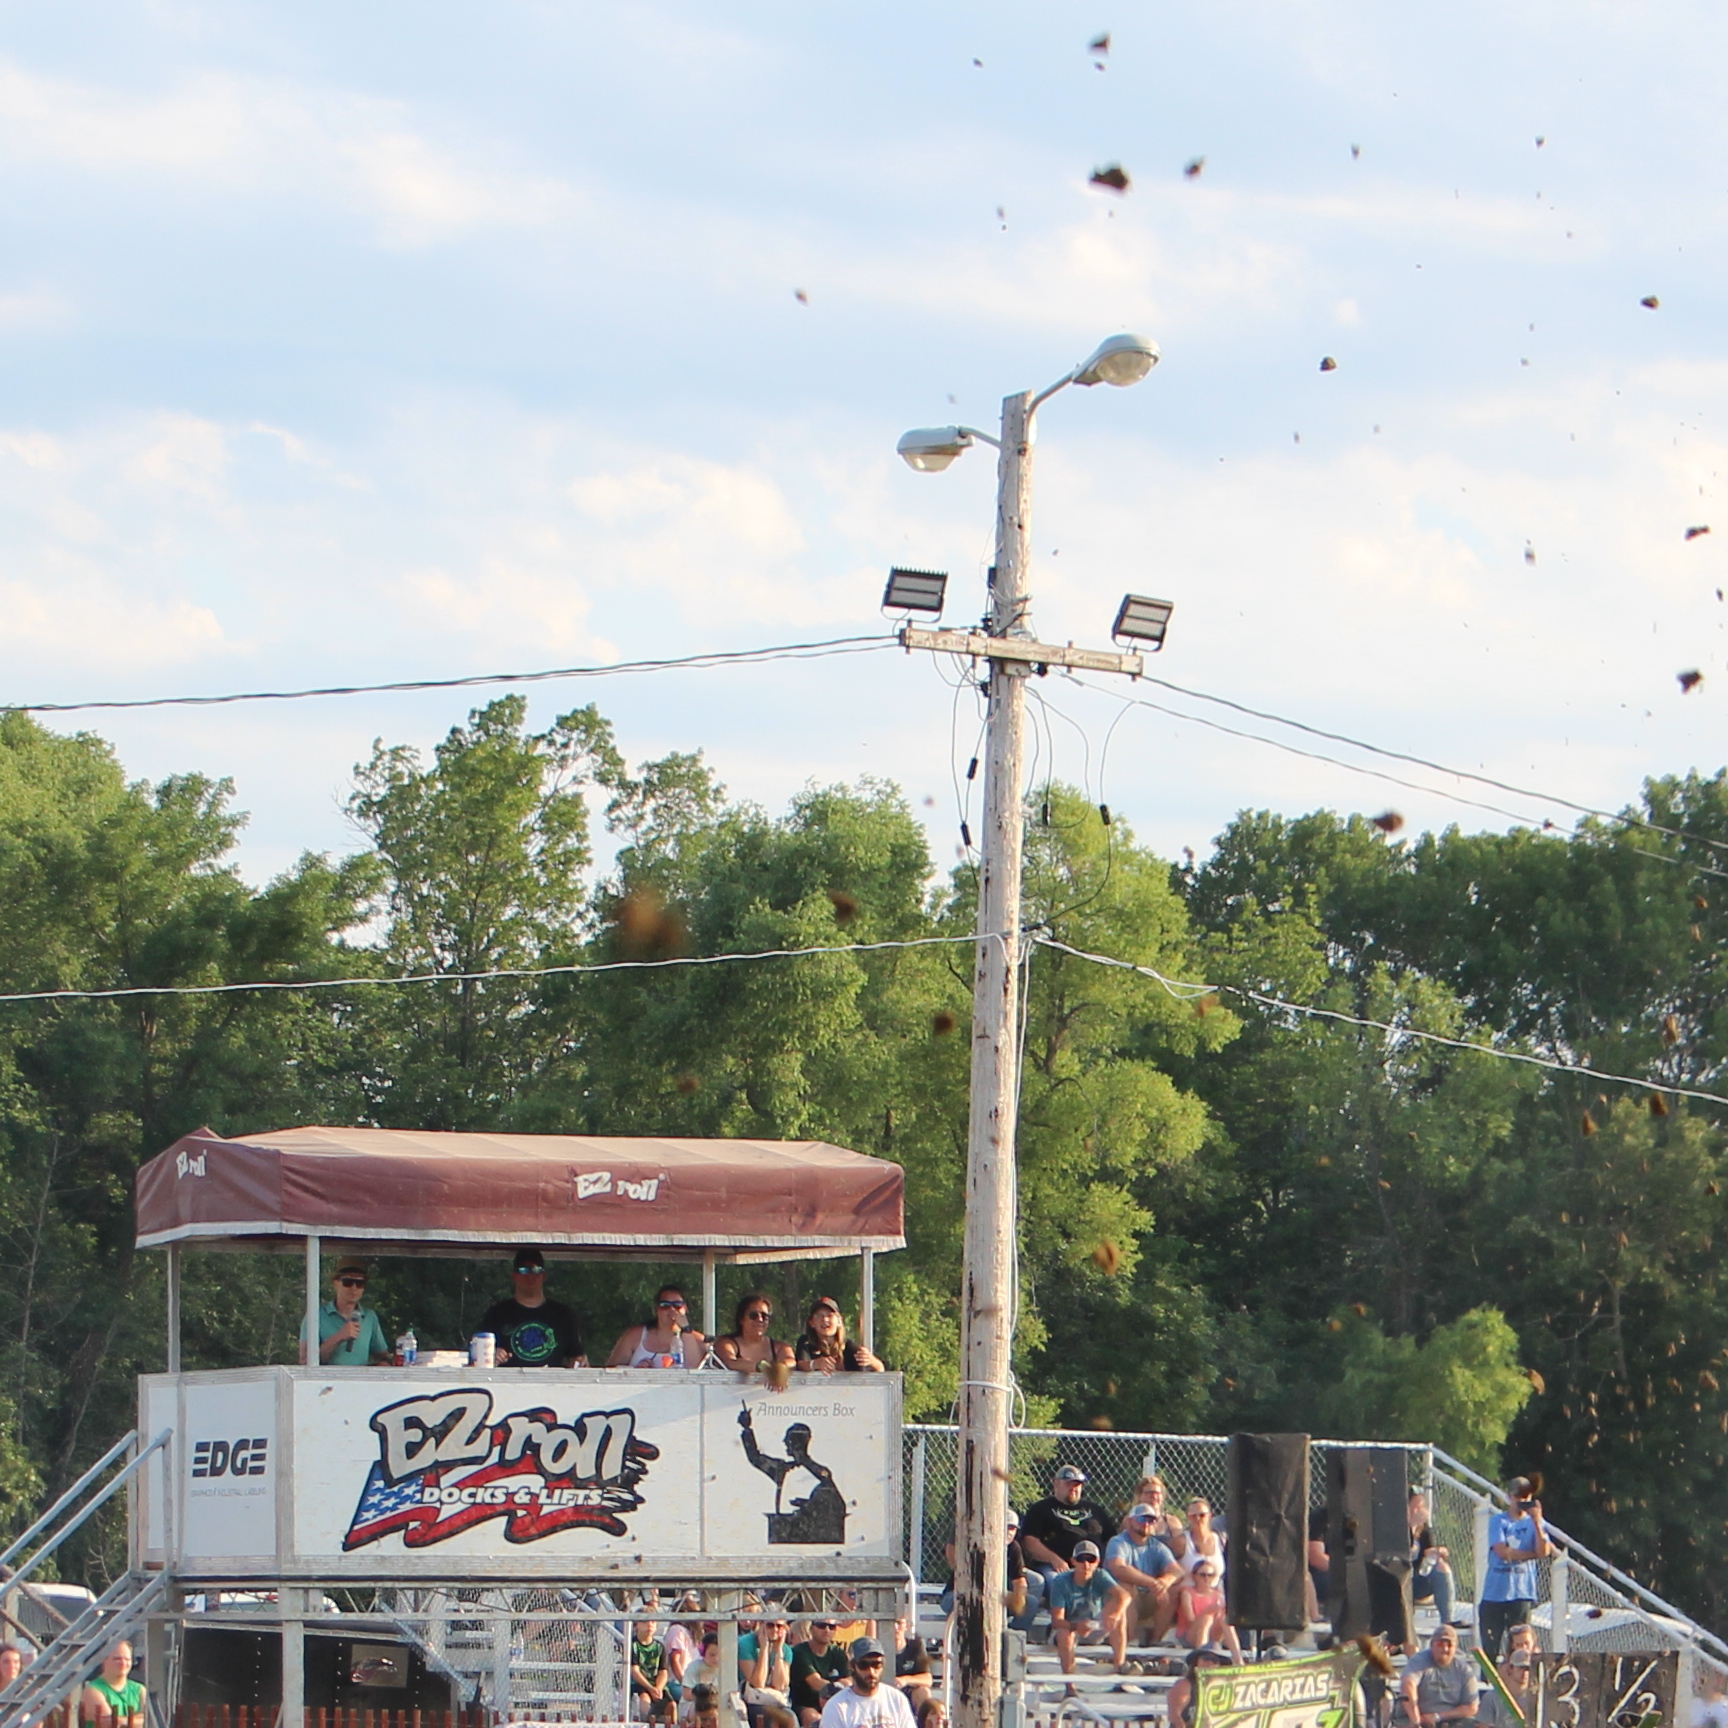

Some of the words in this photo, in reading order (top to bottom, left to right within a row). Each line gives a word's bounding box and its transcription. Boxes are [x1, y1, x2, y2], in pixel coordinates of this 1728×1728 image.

[573, 1171, 612, 1200] EZ
[616, 1179, 659, 1201] roll
[756, 1402, 829, 1417] Announcers
[832, 1402, 856, 1418] Box
[372, 1389, 492, 1485] EZ
[499, 1407, 635, 1484] roll
[191, 1438, 268, 1478] EDGE
[422, 1486, 508, 1505] DOCKS
[512, 1486, 534, 1505] &
[537, 1486, 604, 1507] LIFTS
[1206, 1681, 1233, 1714] CJ
[1233, 1673, 1331, 1709] ZACARIAS
